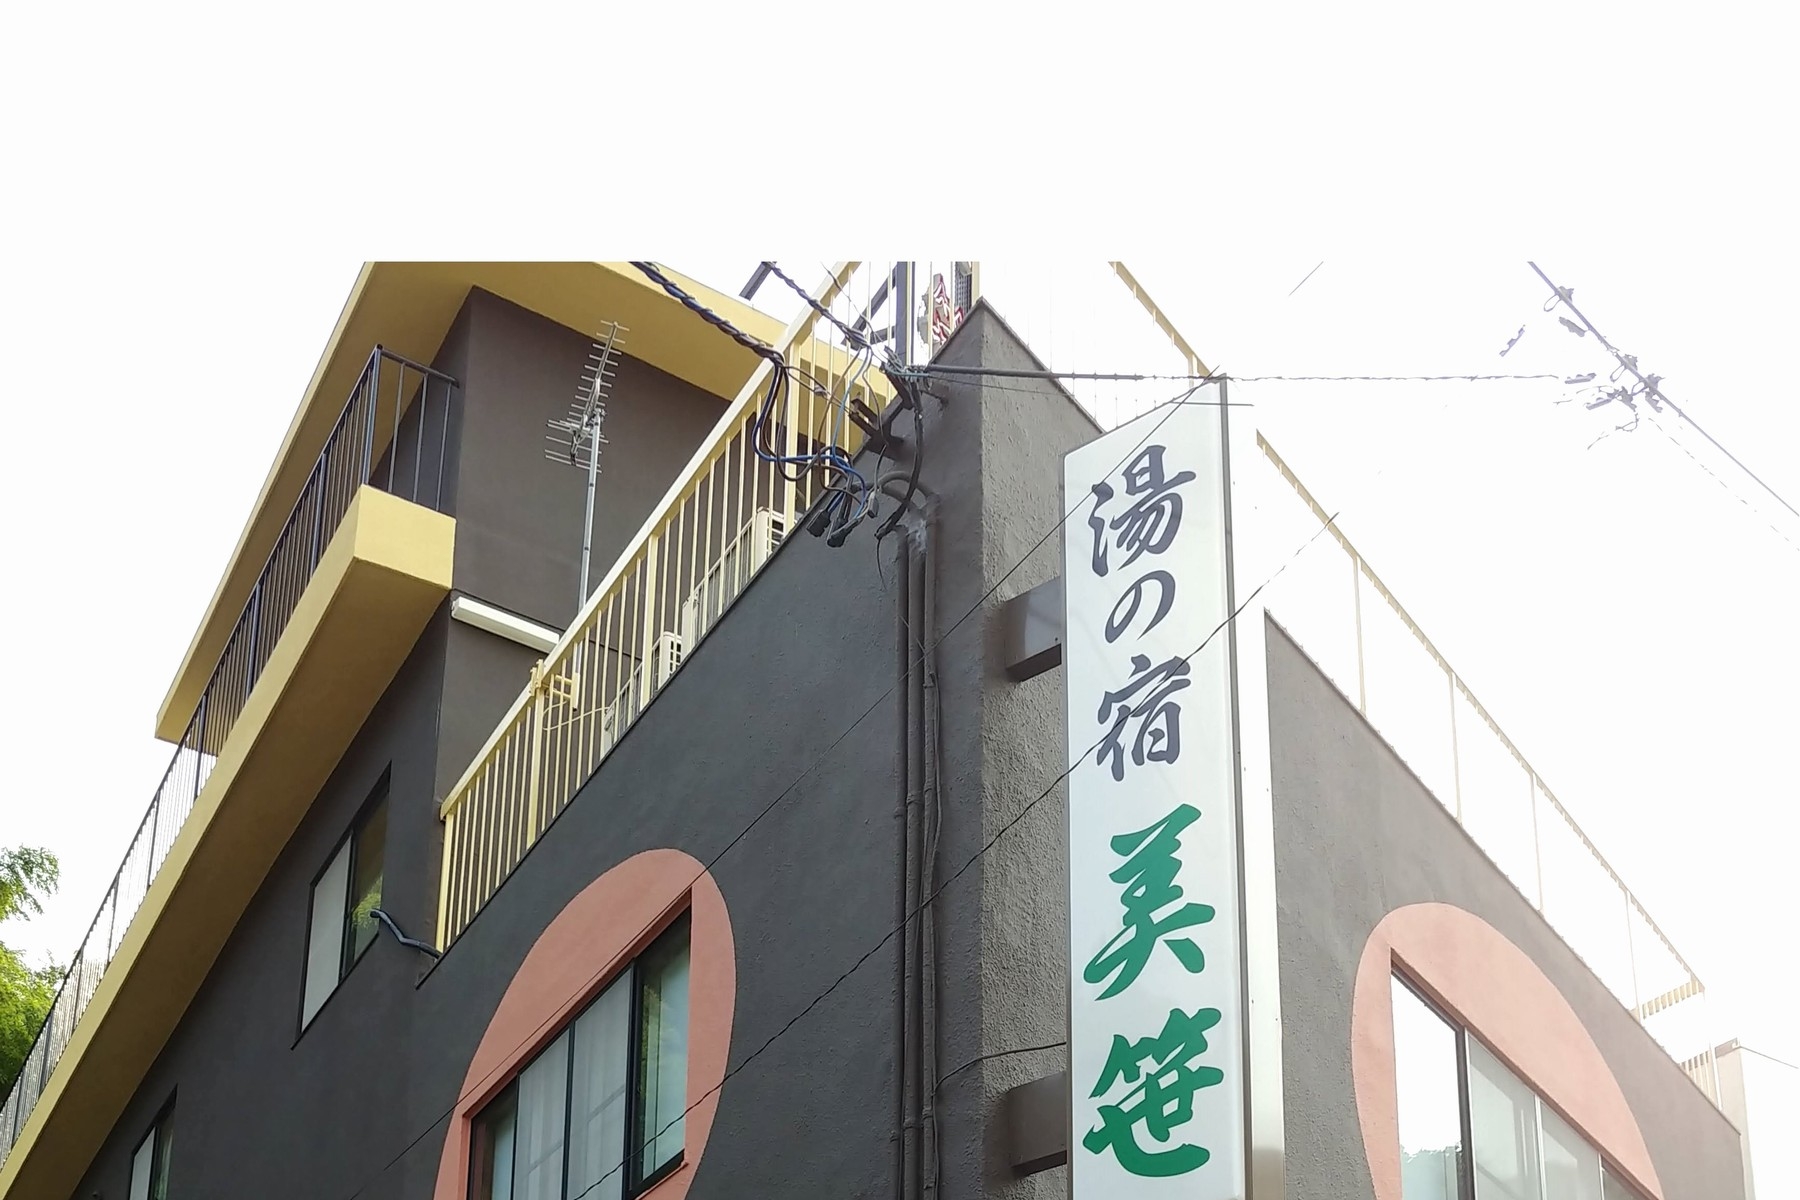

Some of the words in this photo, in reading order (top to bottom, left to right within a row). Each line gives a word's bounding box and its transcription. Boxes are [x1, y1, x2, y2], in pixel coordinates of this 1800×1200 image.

[1088, 445, 1197, 782] 湯の宿
[1083, 803, 1224, 1177] 美笹
